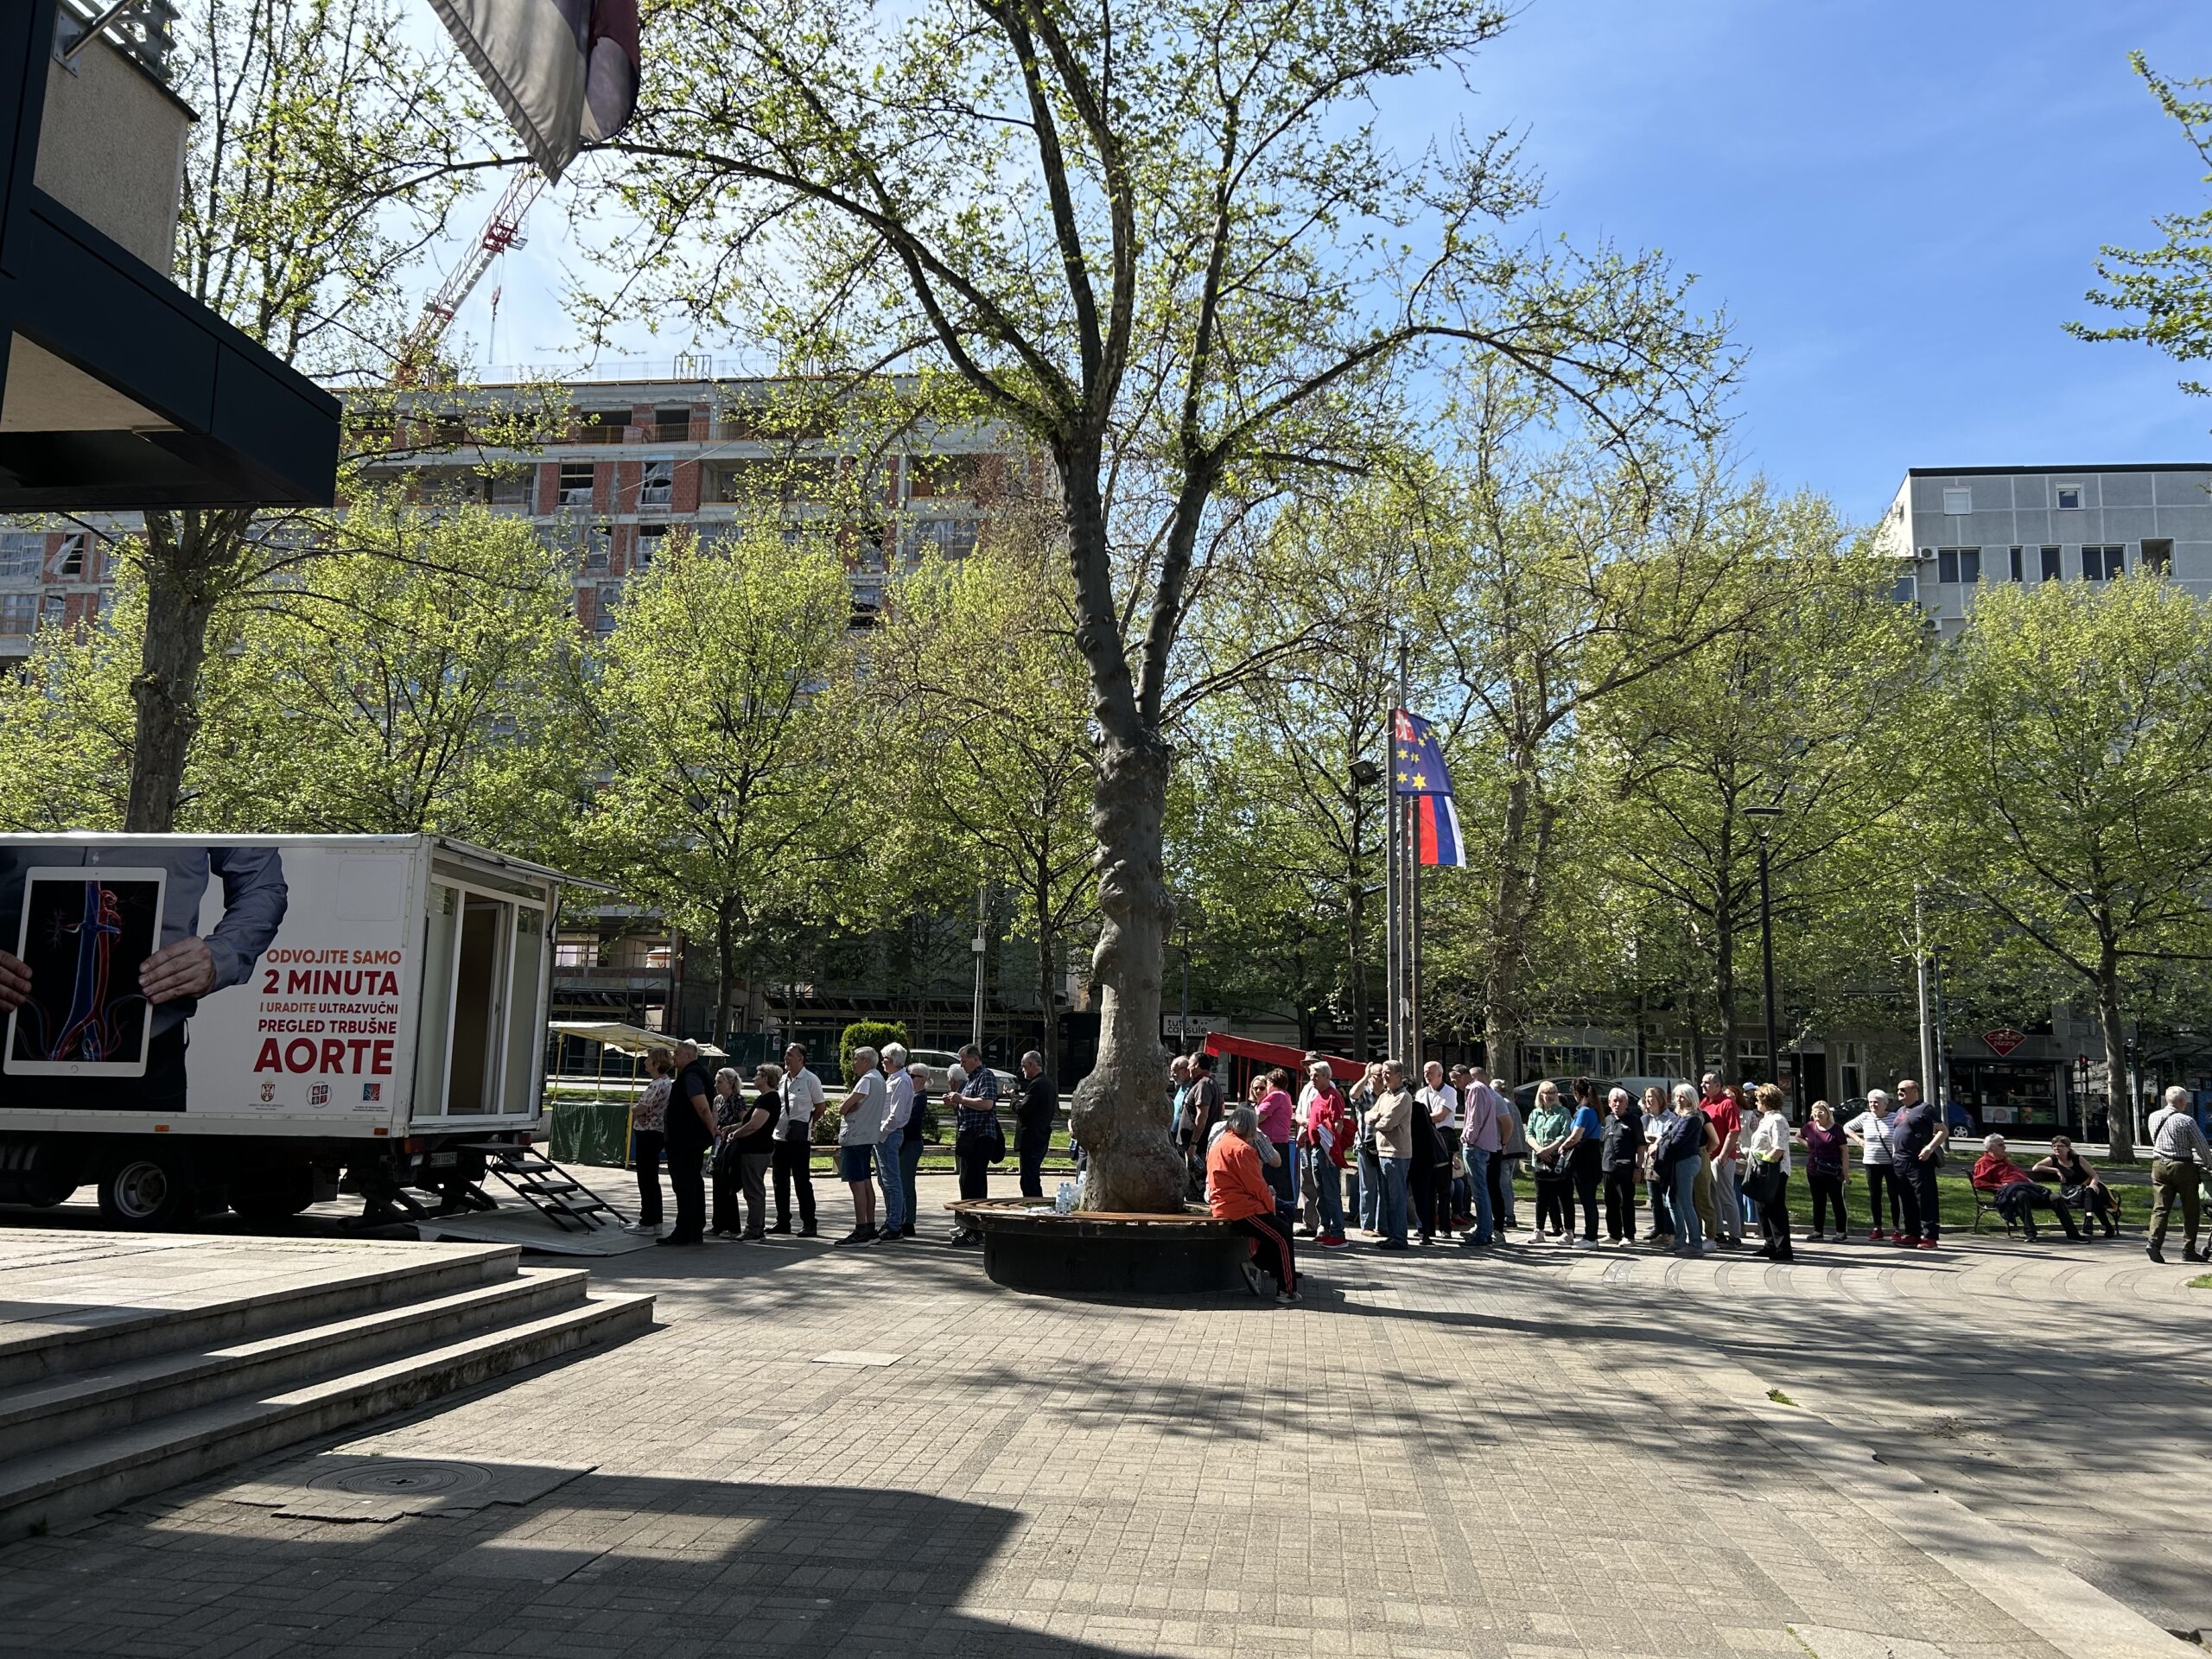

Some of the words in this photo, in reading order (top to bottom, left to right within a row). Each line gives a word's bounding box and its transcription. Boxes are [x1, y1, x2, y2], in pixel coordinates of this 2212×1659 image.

[266, 950, 348, 963] ODVOJITE
[352, 950, 402, 964] SAMO
[263, 969, 279, 994] 2
[288, 970, 398, 995] MINUTA
[260, 1002, 264, 1012] I
[267, 1002, 316, 1013] URADITE
[319, 1001, 397, 1014] ULTRAZVUČNI
[258, 1020, 325, 1033] PREGLED
[329, 1018, 397, 1033] TRBUŠNE
[1167, 1026, 1207, 1036] casule
[253, 1038, 394, 1074] AORTE
